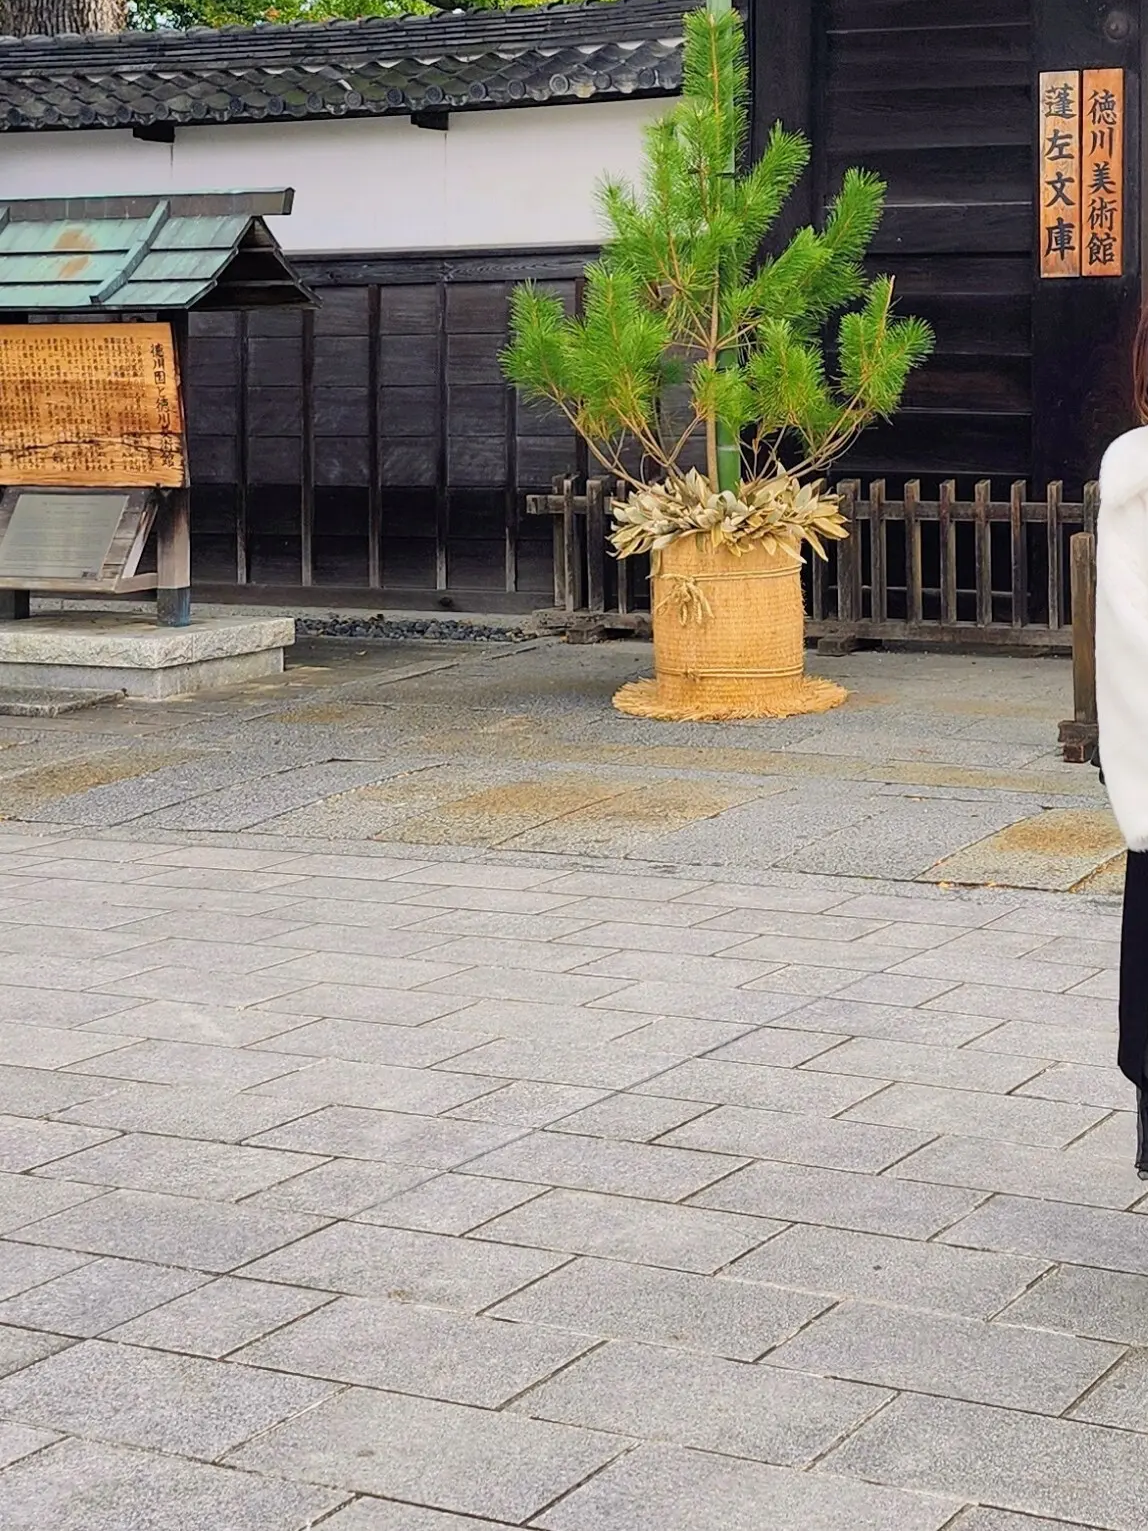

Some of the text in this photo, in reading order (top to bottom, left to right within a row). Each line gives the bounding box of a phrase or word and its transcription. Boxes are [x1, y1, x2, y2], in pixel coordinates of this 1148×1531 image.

[1044, 83, 1077, 261] 蓬左文庫
[1087, 90, 1118, 266] 徳川美術館
